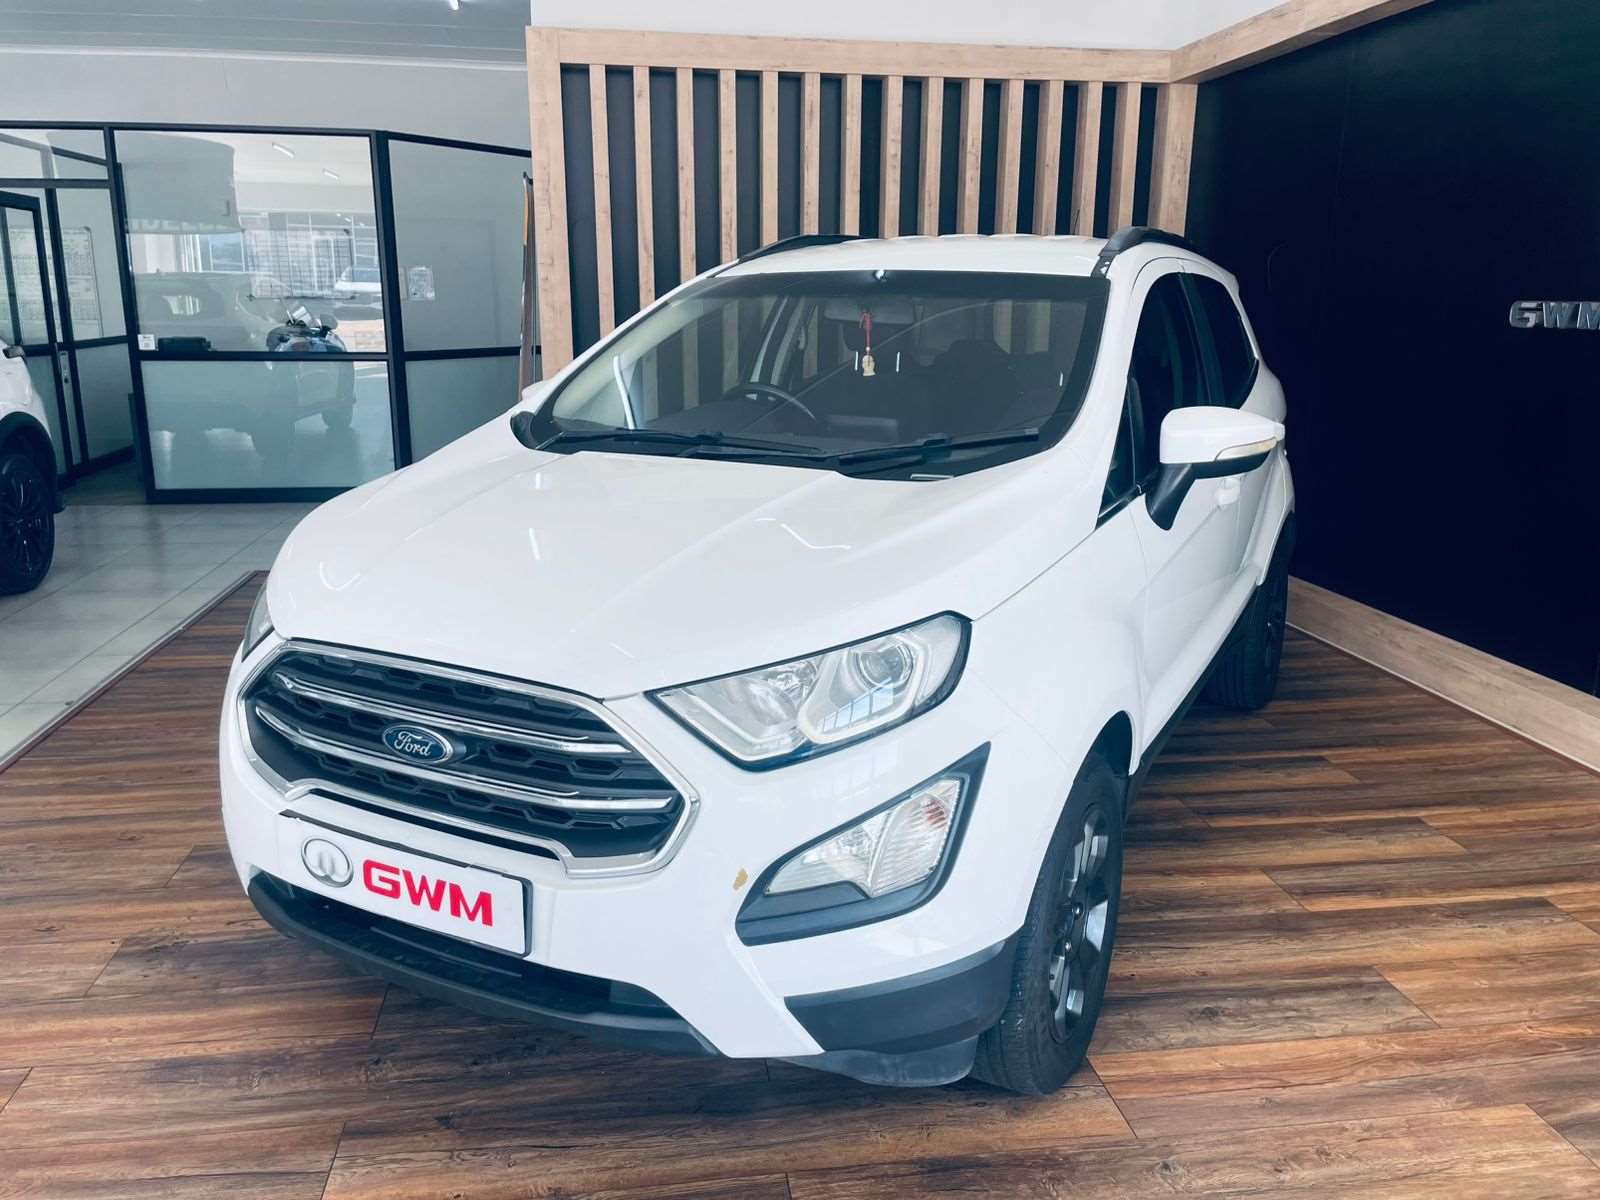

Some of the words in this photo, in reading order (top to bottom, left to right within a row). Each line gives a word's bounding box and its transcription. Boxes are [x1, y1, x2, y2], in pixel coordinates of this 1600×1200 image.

[1509, 301, 1600, 329] GWM
[394, 731, 431, 756] Ford
[363, 859, 493, 927] GWM
